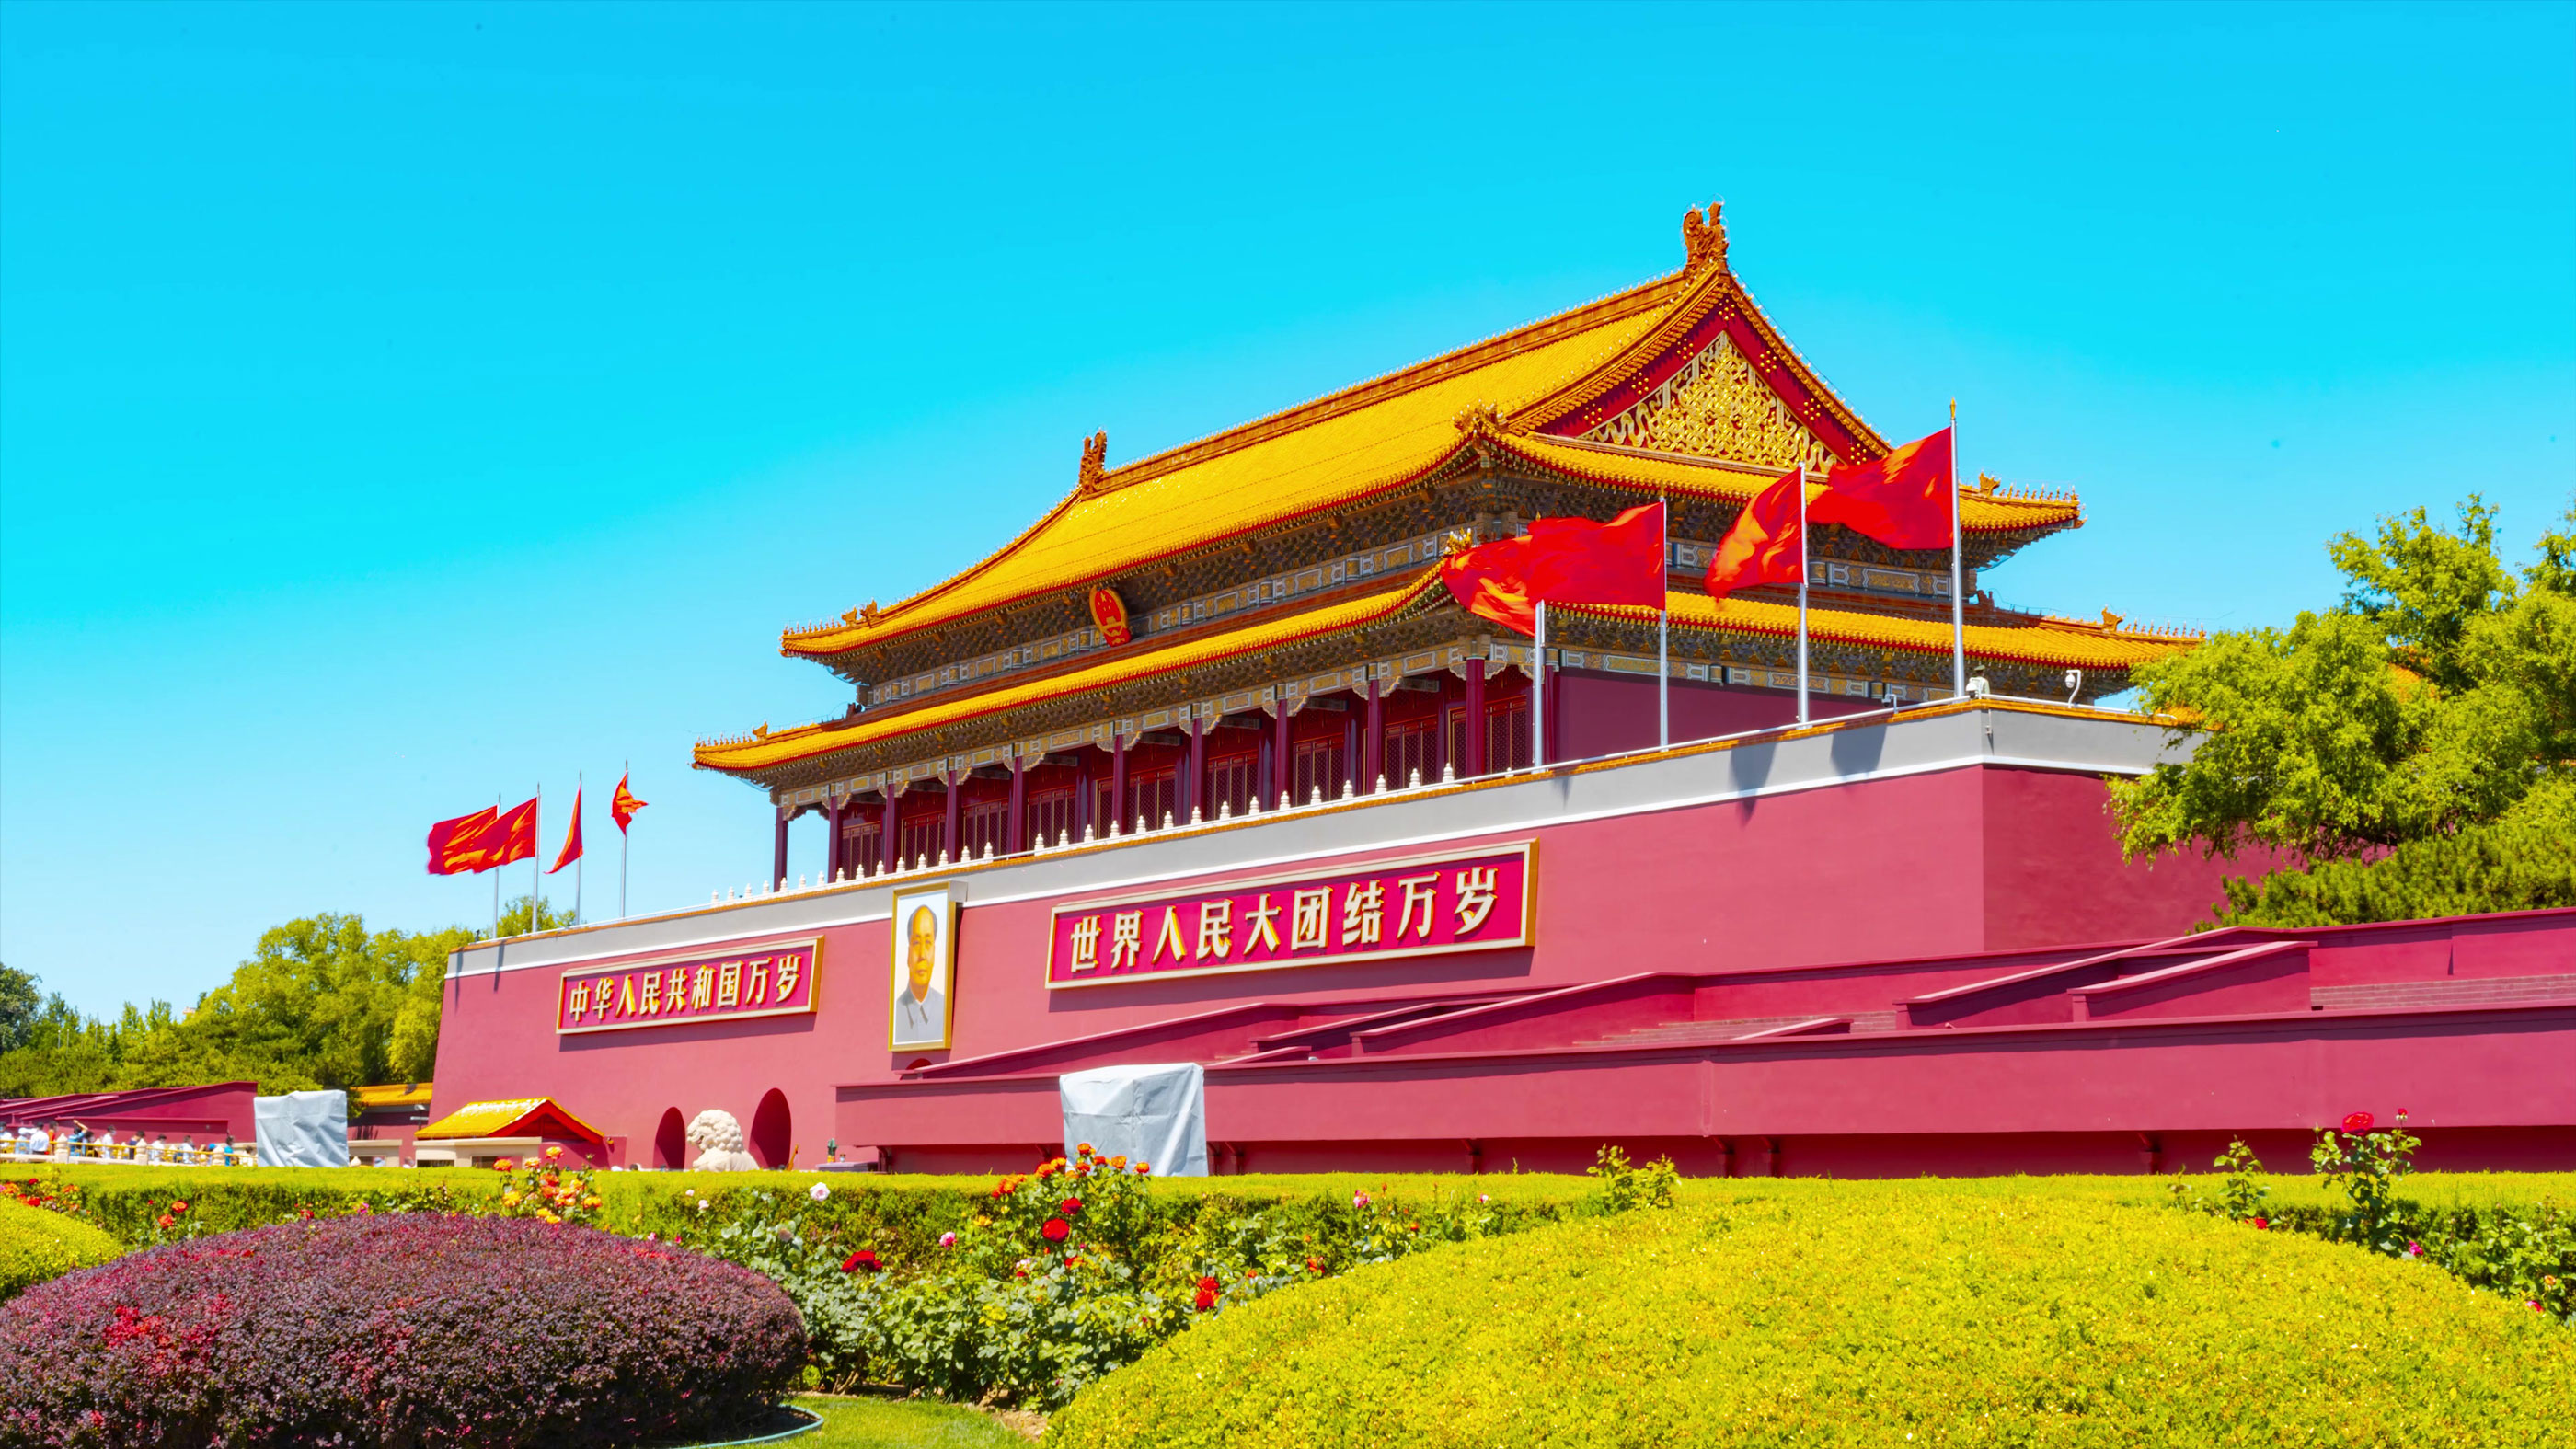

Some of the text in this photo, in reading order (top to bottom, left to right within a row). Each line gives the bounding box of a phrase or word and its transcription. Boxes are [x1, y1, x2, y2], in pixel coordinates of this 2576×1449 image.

[1070, 867, 1499, 972] 世界人民大团结万岁
[569, 954, 803, 1022] 中华人民共和国万岁
